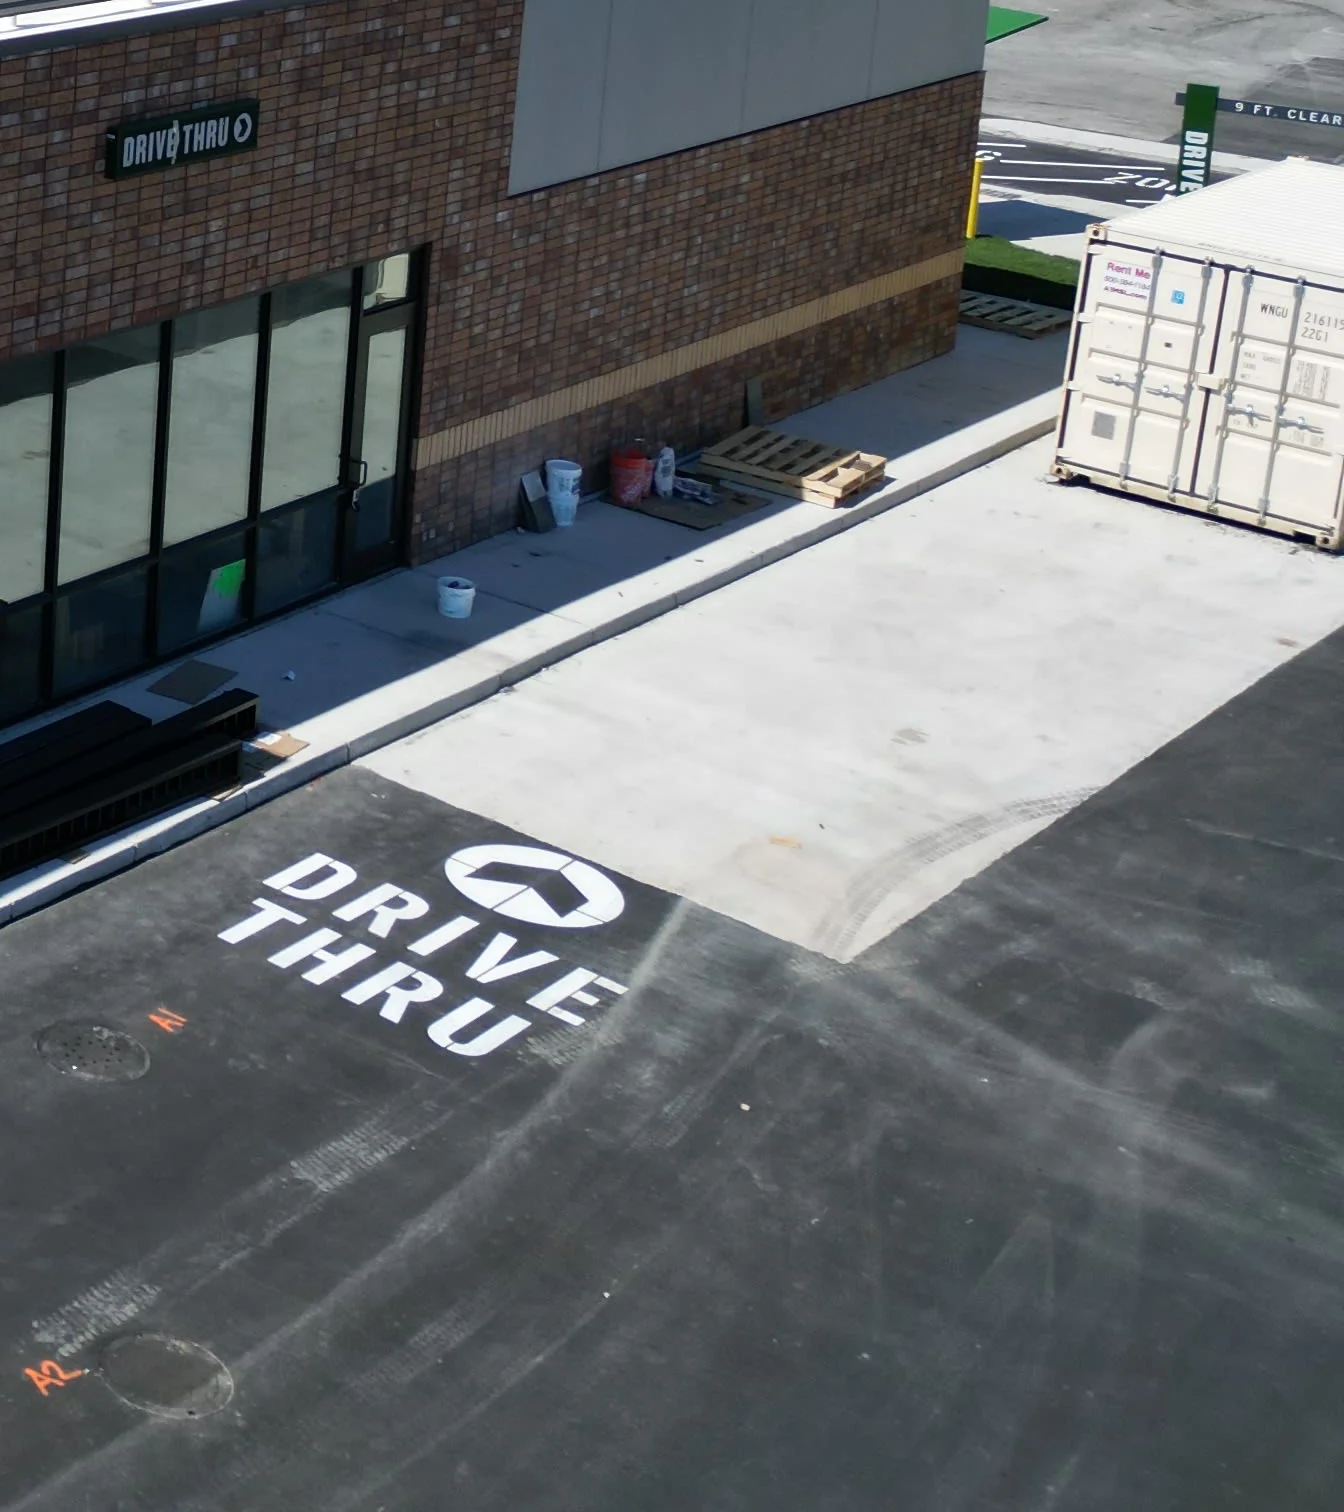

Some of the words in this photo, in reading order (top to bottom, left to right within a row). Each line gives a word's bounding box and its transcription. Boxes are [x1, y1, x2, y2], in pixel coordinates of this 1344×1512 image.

[1235, 102, 1244, 112] 9
[122, 127, 178, 168] DRIVE
[182, 116, 230, 154] THRU
[1260, 304, 1288, 318] WNGU
[262, 852, 630, 1028] DRIVE
[216, 897, 532, 1057] THRU
